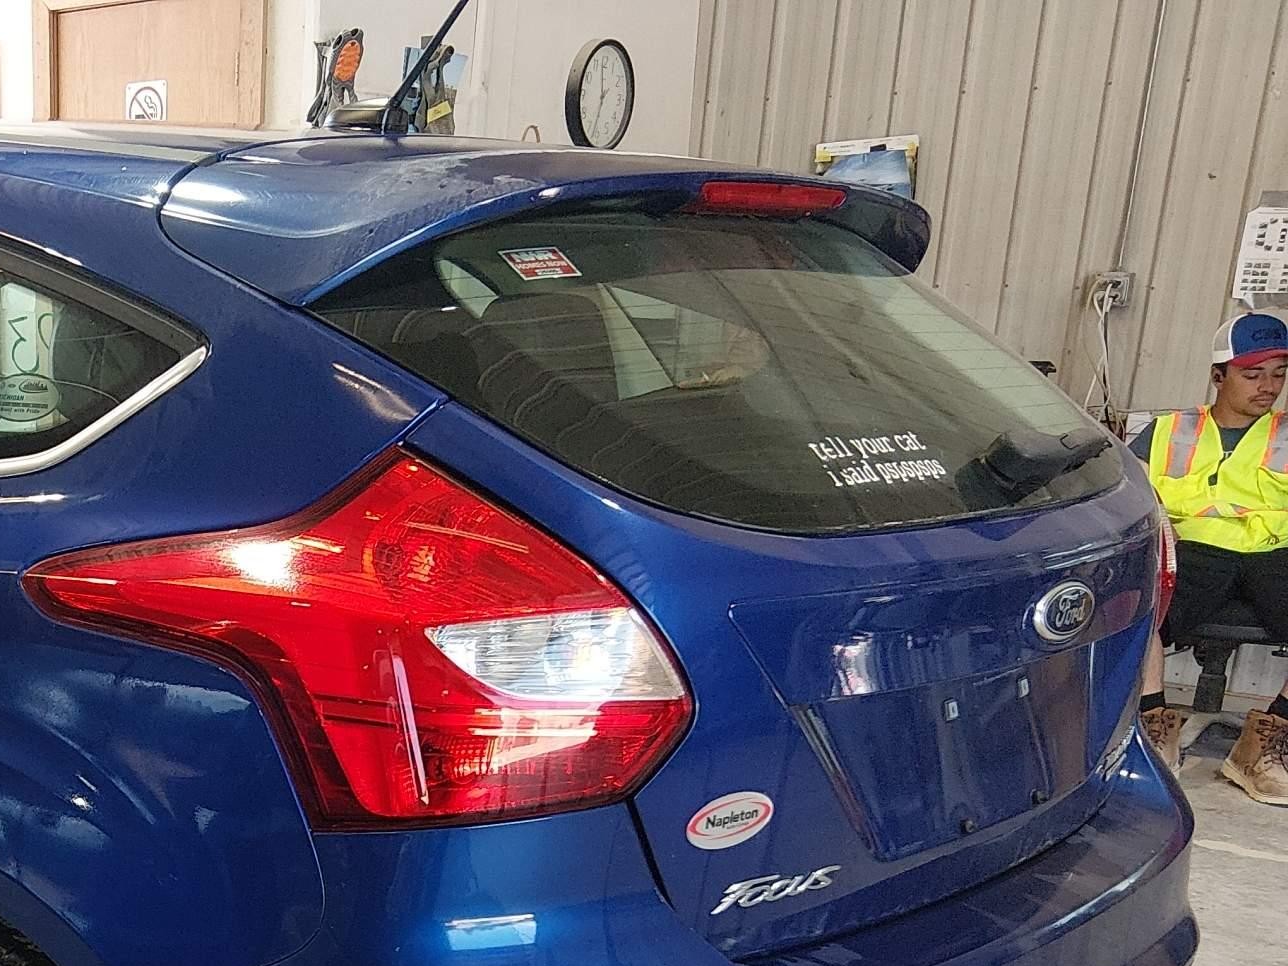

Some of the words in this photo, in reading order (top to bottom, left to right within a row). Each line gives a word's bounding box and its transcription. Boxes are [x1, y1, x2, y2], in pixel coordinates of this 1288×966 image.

[808, 436, 854, 461] tell
[849, 436, 896, 459] your
[893, 430, 927, 452] cat
[822, 464, 843, 487] i
[840, 459, 881, 486] said
[875, 458, 947, 484] pspspsps
[1055, 590, 1086, 628] Ford
[705, 808, 759, 830] Napleton
